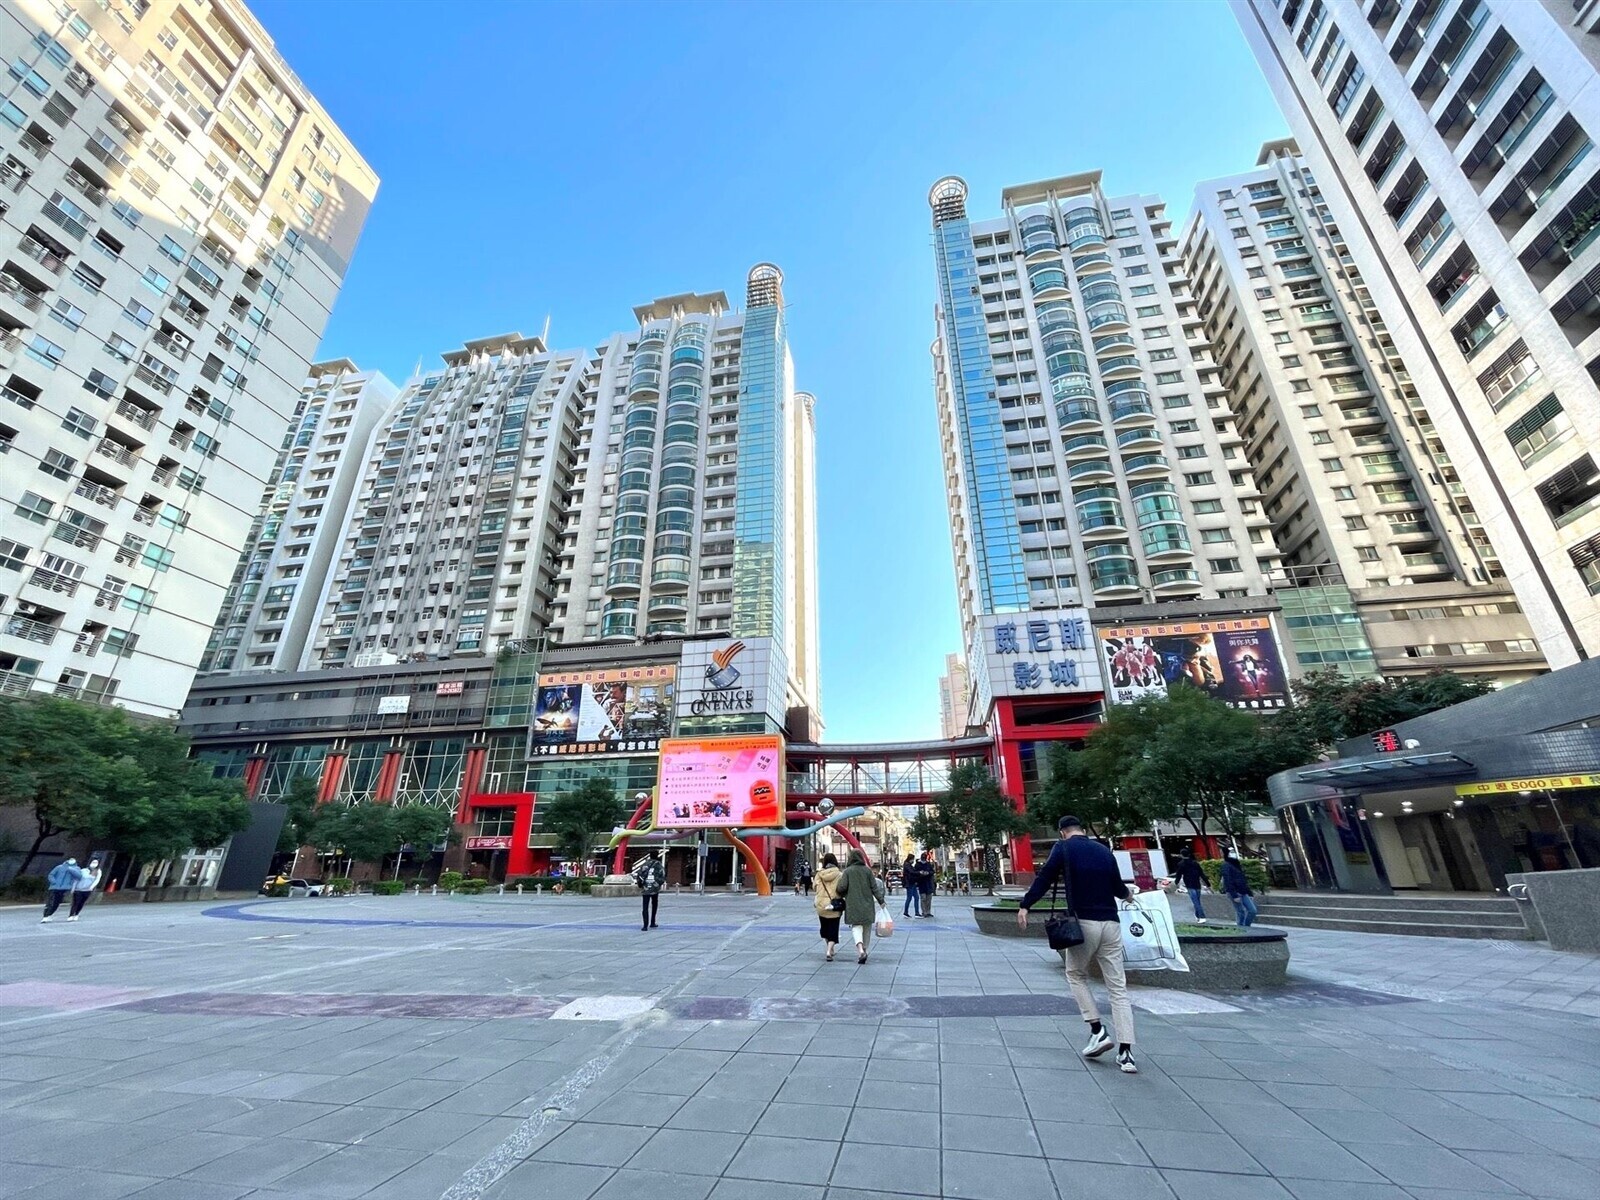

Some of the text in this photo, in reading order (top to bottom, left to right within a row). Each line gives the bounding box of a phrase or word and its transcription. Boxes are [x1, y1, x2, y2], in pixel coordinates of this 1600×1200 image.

[993, 616, 1087, 655] 威尼斯
[1109, 625, 1184, 637] 威尼斯影城
[547, 672, 606, 684] 威尼斯影城
[1013, 658, 1081, 691] 影城
[701, 689, 754, 703] VENICE
[690, 698, 753, 715] CINEMAS
